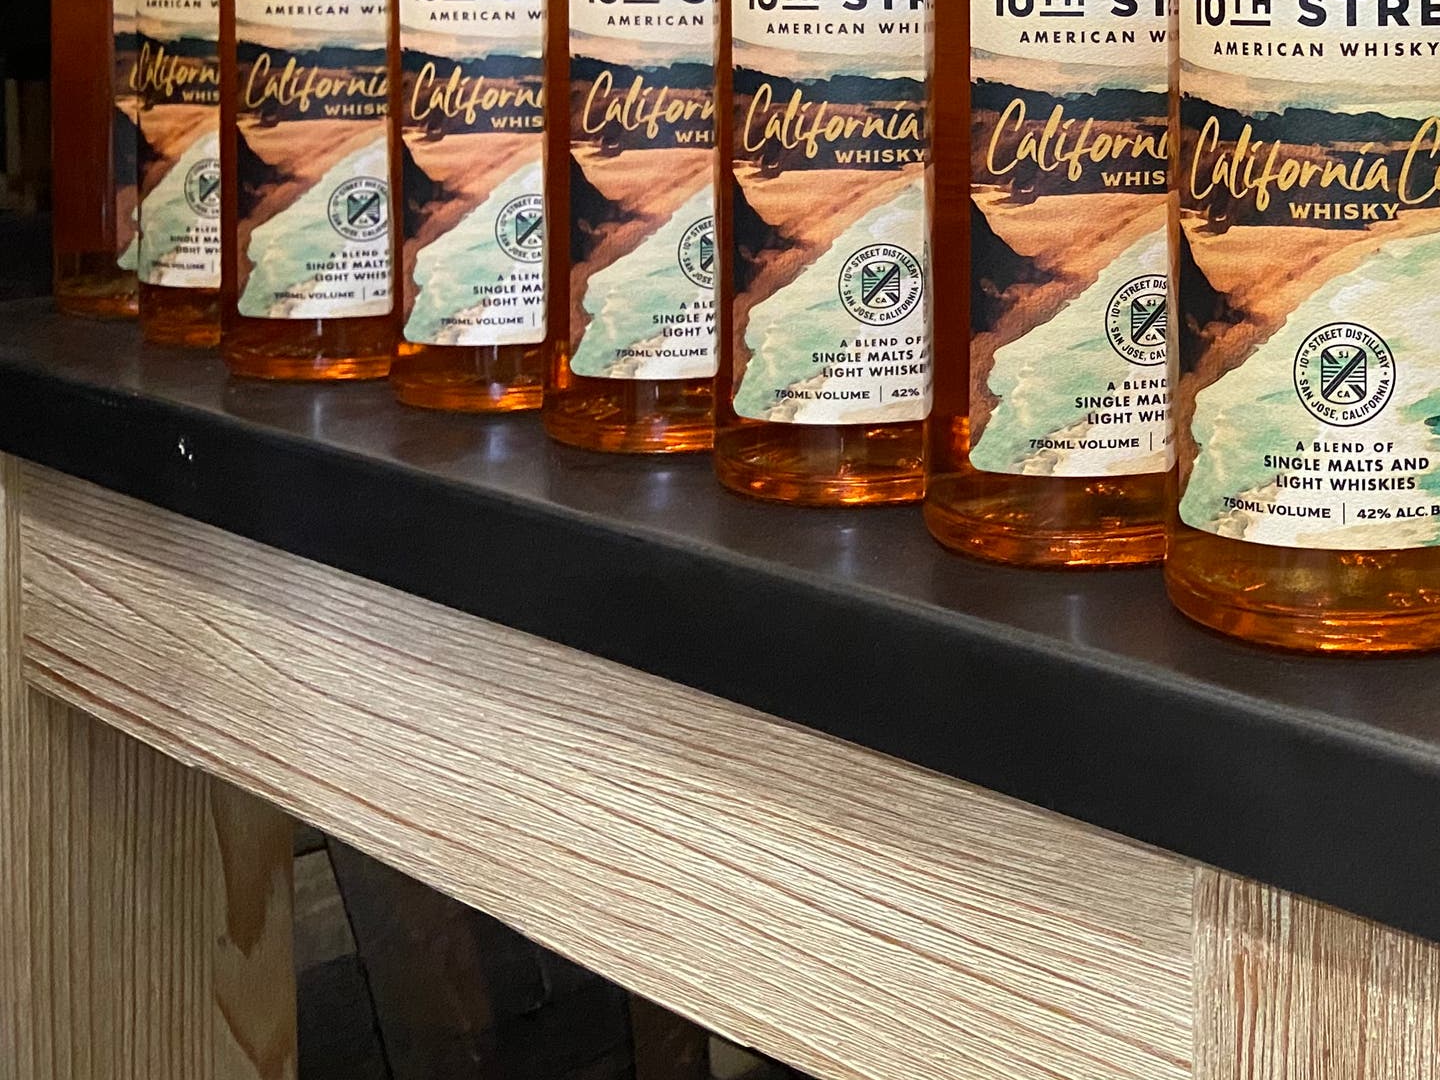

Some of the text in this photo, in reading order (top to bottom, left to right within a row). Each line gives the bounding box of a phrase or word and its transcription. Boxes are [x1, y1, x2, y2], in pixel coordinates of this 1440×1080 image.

[266, 6, 349, 15] AMERICAN
[430, 12, 515, 20] AMERICAN
[607, 16, 704, 26] AMERICAN
[767, 23, 919, 34] AMERICAN WHI
[1020, 31, 1135, 43] AMERICAN
[1214, 41, 1323, 57] AMERICAN
[1340, 42, 1439, 57] WHISKY
[743, 83, 919, 158] California
[835, 149, 924, 163] WHISKY
[1191, 116, 1390, 211] California
[1102, 171, 1166, 186] WHIS
[1289, 203, 1399, 219] WHISKY
[852, 249, 919, 279] STREET DISTILLERY
[315, 273, 348, 282] LIGHT
[473, 286, 515, 294] SINGLE
[1120, 280, 1150, 301] STREET
[483, 299, 517, 307] LIGHT
[844, 290, 856, 307] SAN
[880, 287, 919, 321] CALIFORNIA
[652, 315, 699, 324] SINGLE
[663, 328, 700, 337] LIGHT
[856, 339, 898, 347] BLEND
[906, 337, 921, 347] OF
[1111, 327, 1146, 361] SAN JOSE,
[655, 348, 708, 356] VOLUME
[1308, 328, 1342, 353] STREET
[1346, 328, 1390, 368] DISTILLERY
[812, 350, 913, 363] SINGLE MALTS
[823, 368, 863, 378] LIGHT
[1107, 382, 1115, 390] A
[775, 388, 920, 399] 750ML VOLUME 42%
[1337, 390, 1350, 398] CA
[1075, 396, 1130, 408] SINGLE
[1299, 378, 1390, 421] SAN JOSE, CALIFORNIA
[1087, 413, 1132, 424] LIGHT
[1029, 438, 1139, 449] 750ML VOLUME
[1296, 442, 1394, 453] A BLEND OF
[1264, 455, 1429, 472] SINGLE MALTS AND
[1276, 476, 1416, 491] LIGHT WHISKIES
[1223, 497, 1264, 513] 750ML
[1267, 505, 1331, 519] VOLUME
[1357, 508, 1392, 519] 42%
[1396, 505, 1428, 518] ALC.
